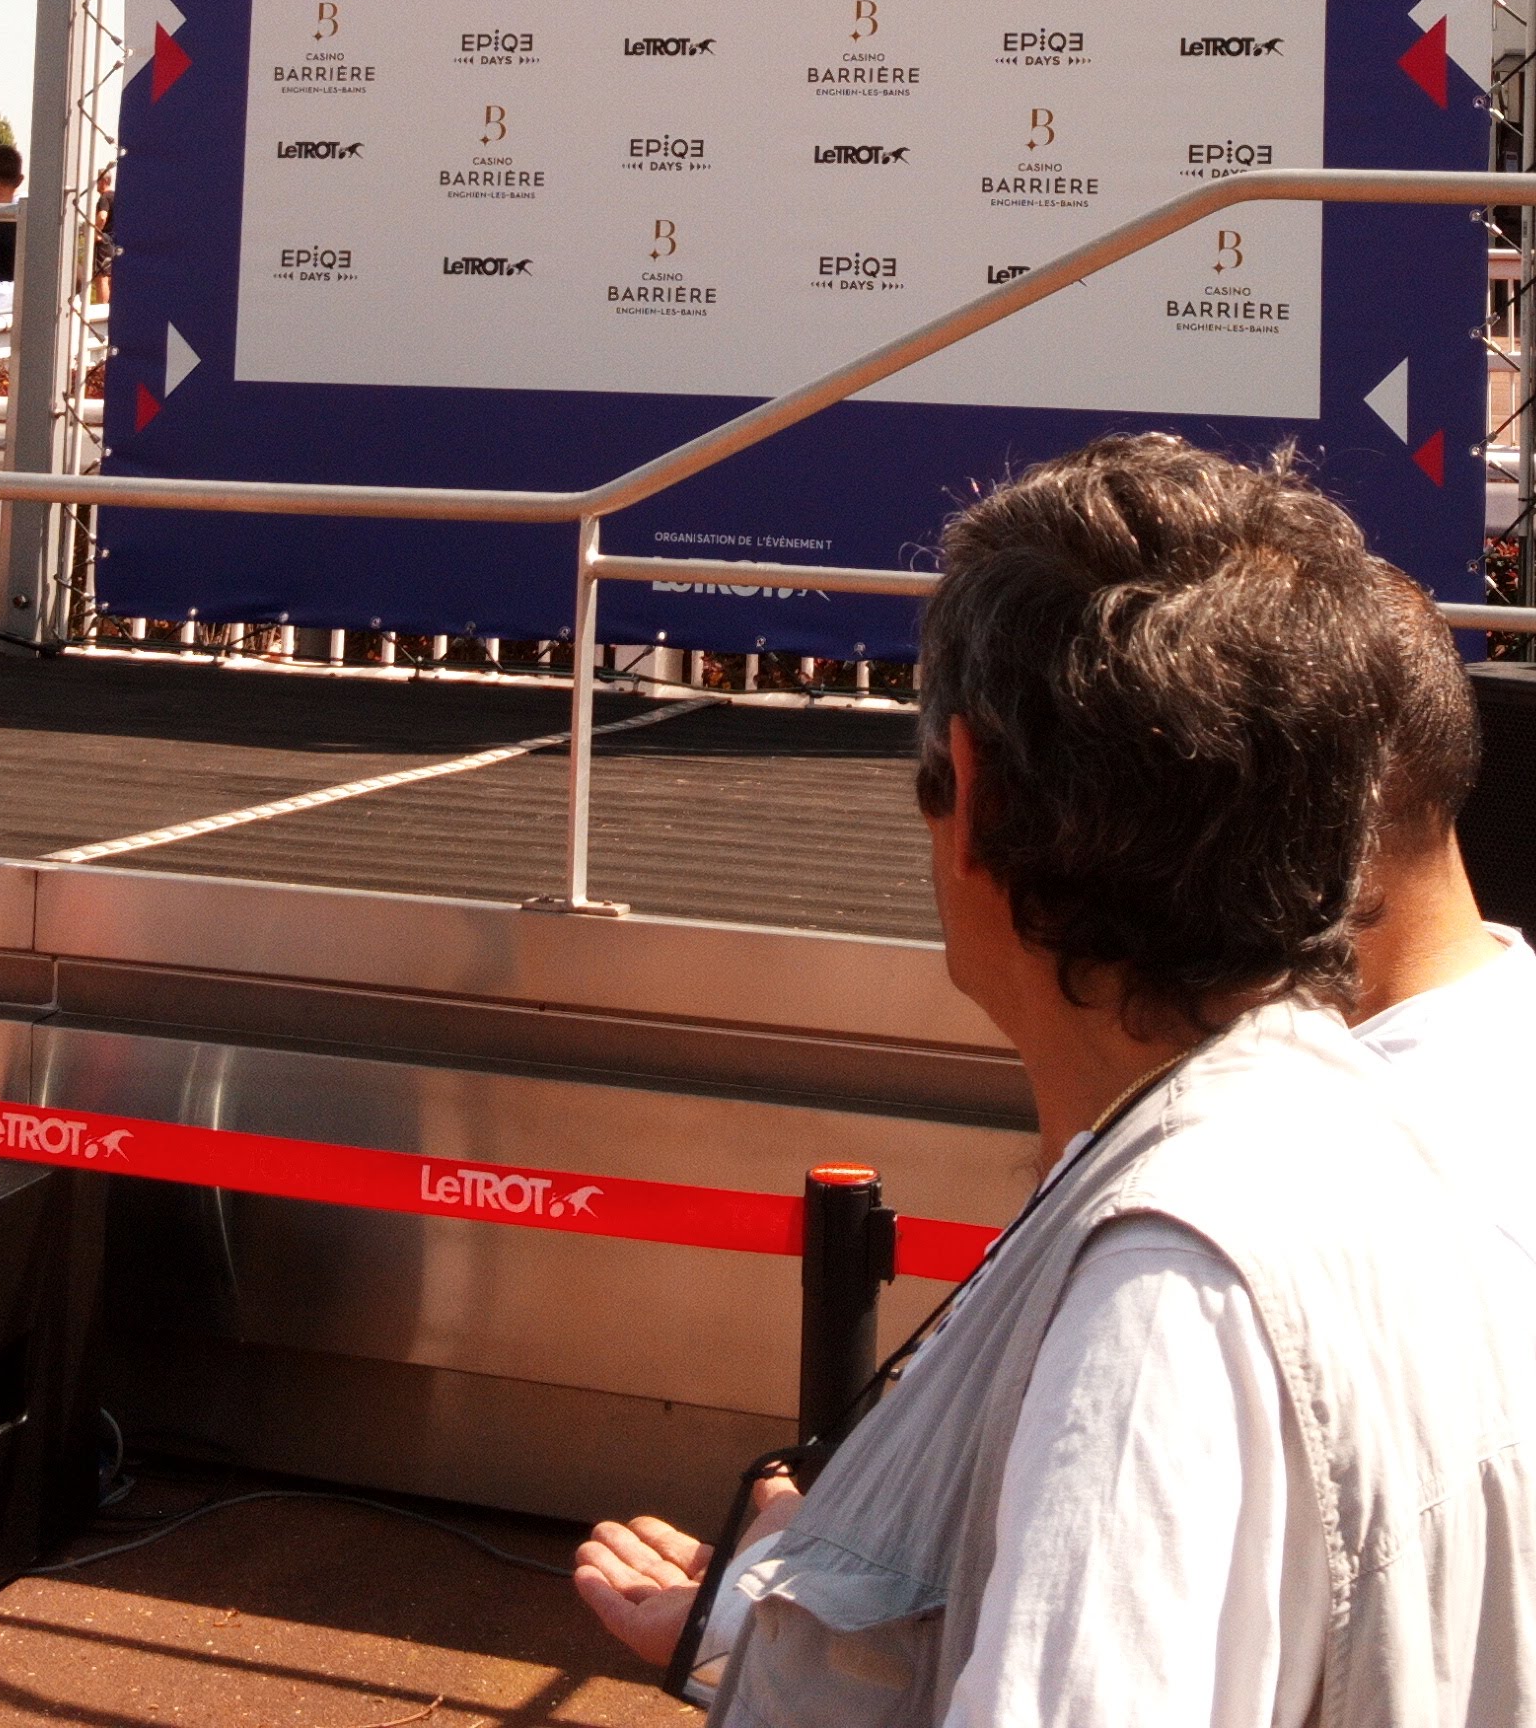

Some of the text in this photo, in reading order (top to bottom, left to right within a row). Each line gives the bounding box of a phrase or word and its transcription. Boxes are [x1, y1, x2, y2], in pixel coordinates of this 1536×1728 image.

[306, 52, 344, 61] CASINO
[481, 55, 512, 64] DAYS
[843, 52, 884, 61] CASINO
[1025, 56, 1060, 65] DAYS
[274, 66, 374, 81] BARRIÈRE
[808, 66, 919, 83] BARRIÈRE
[473, 156, 512, 165] CASINO
[650, 162, 682, 171] DAYS
[1018, 163, 1062, 172] CASINO
[440, 170, 544, 186] BARRIÈRE
[982, 177, 1098, 194] BARRIÈRE
[300, 272, 330, 281] DAYS
[642, 272, 682, 281] CASINO
[840, 280, 874, 290] DAYS
[608, 286, 716, 303] BARRIÈRE
[1205, 287, 1251, 296] CASINO
[1167, 300, 1289, 320] BARRIÈRE
[654, 532, 735, 545] ORGANISATION
[738, 535, 752, 546] DE
[421, 1164, 551, 1216] LeTROT
